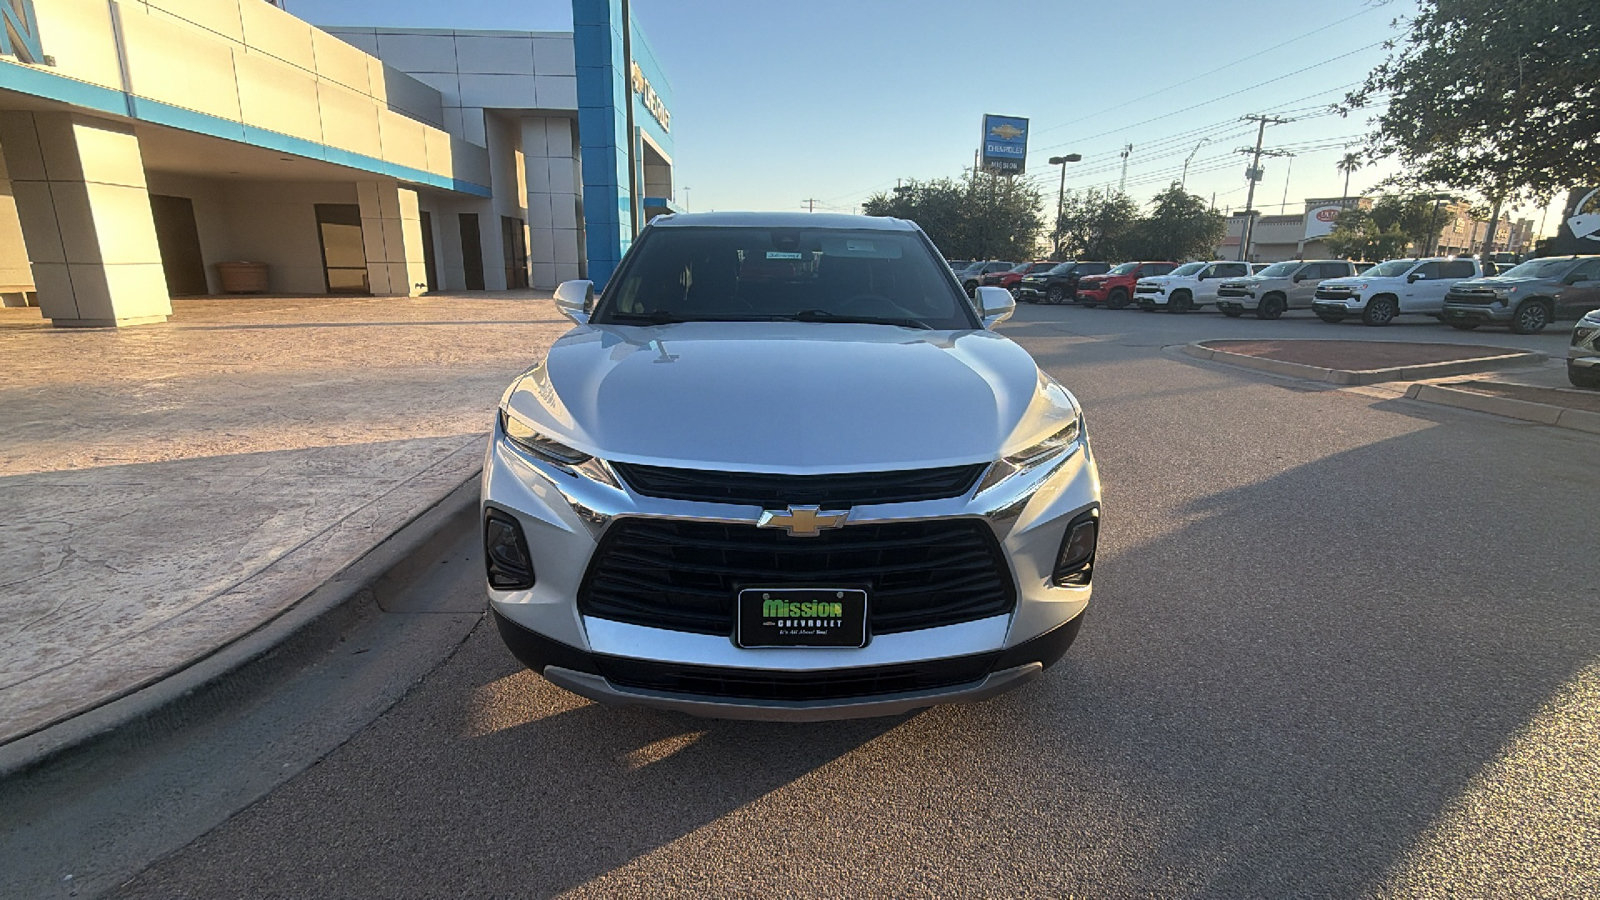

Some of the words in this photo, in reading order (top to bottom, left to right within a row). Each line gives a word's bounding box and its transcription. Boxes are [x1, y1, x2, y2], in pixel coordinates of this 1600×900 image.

[988, 144, 1023, 154] CHEVROLET
[763, 599, 842, 618] Mission
[778, 619, 843, 628] CHEVROLET
